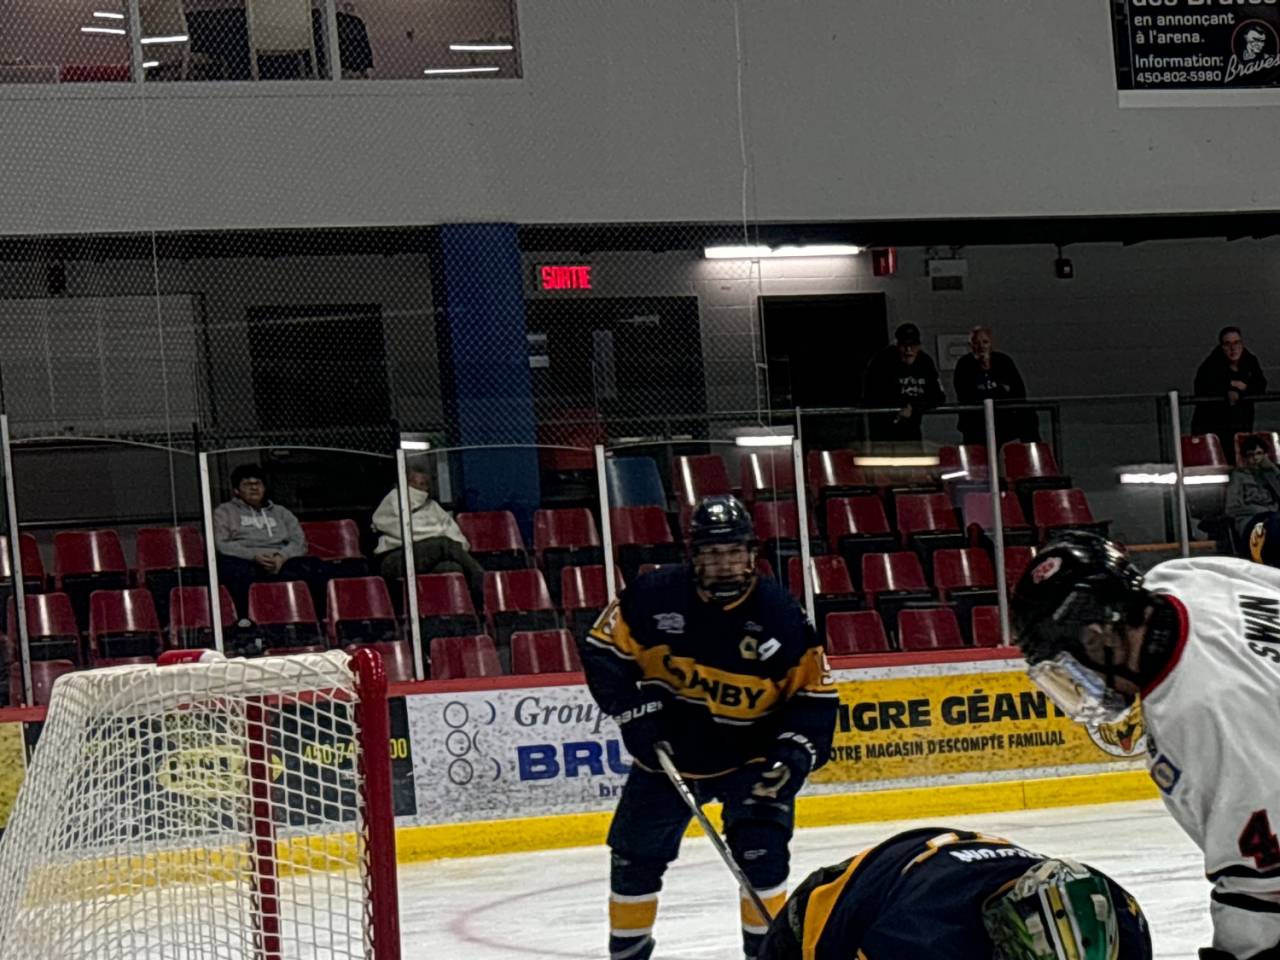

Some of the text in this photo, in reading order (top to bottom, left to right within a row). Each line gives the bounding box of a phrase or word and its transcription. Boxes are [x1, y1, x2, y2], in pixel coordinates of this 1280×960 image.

[1134, 13, 1235, 27] en annonçant
[1136, 30, 1205, 44] à l'arena.
[1135, 54, 1224, 68] Information:
[1136, 70, 1221, 84] 450-802-5980
[542, 266, 592, 290] SORTIE
[839, 698, 931, 733] IGRE
[830, 746, 861, 761] OTRE
[866, 740, 923, 759] MAGASIN
[927, 732, 1005, 756] D'ESCOMPTE
[1008, 730, 1066, 748] FAMILIAL
